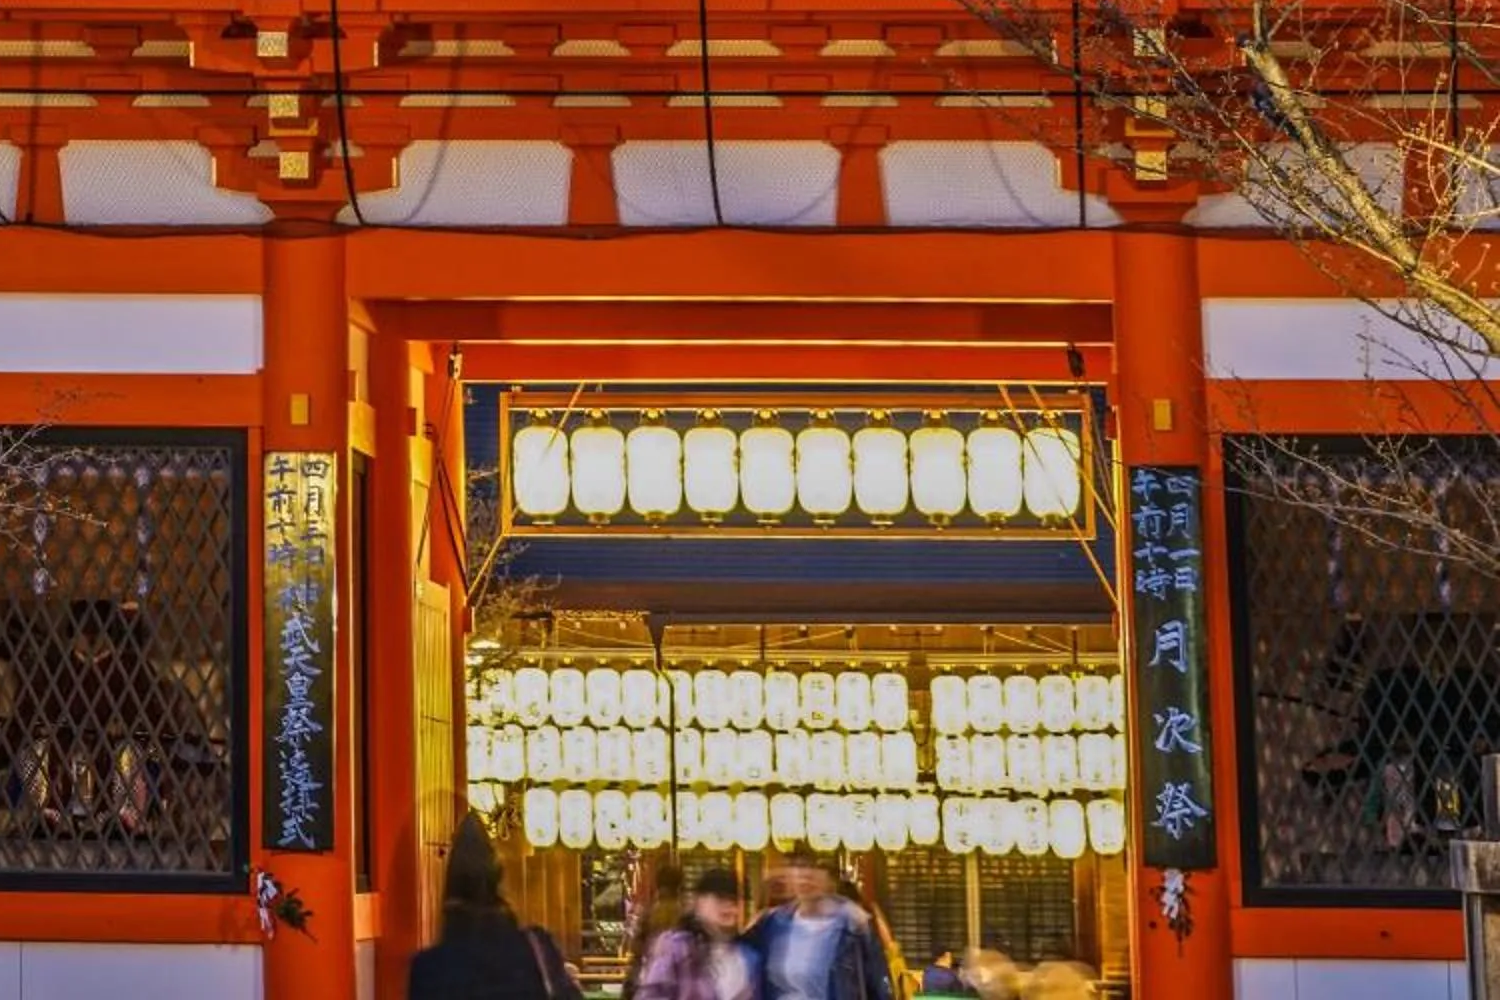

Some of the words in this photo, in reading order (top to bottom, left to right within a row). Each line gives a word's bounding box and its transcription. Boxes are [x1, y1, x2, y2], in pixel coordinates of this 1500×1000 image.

[267, 455, 298, 568] 午前十時
[300, 459, 331, 564] 四月三日
[1132, 469, 1174, 601] 午前十時
[1165, 474, 1201, 592] 四月一日
[1148, 619, 1208, 840] 月次祭
